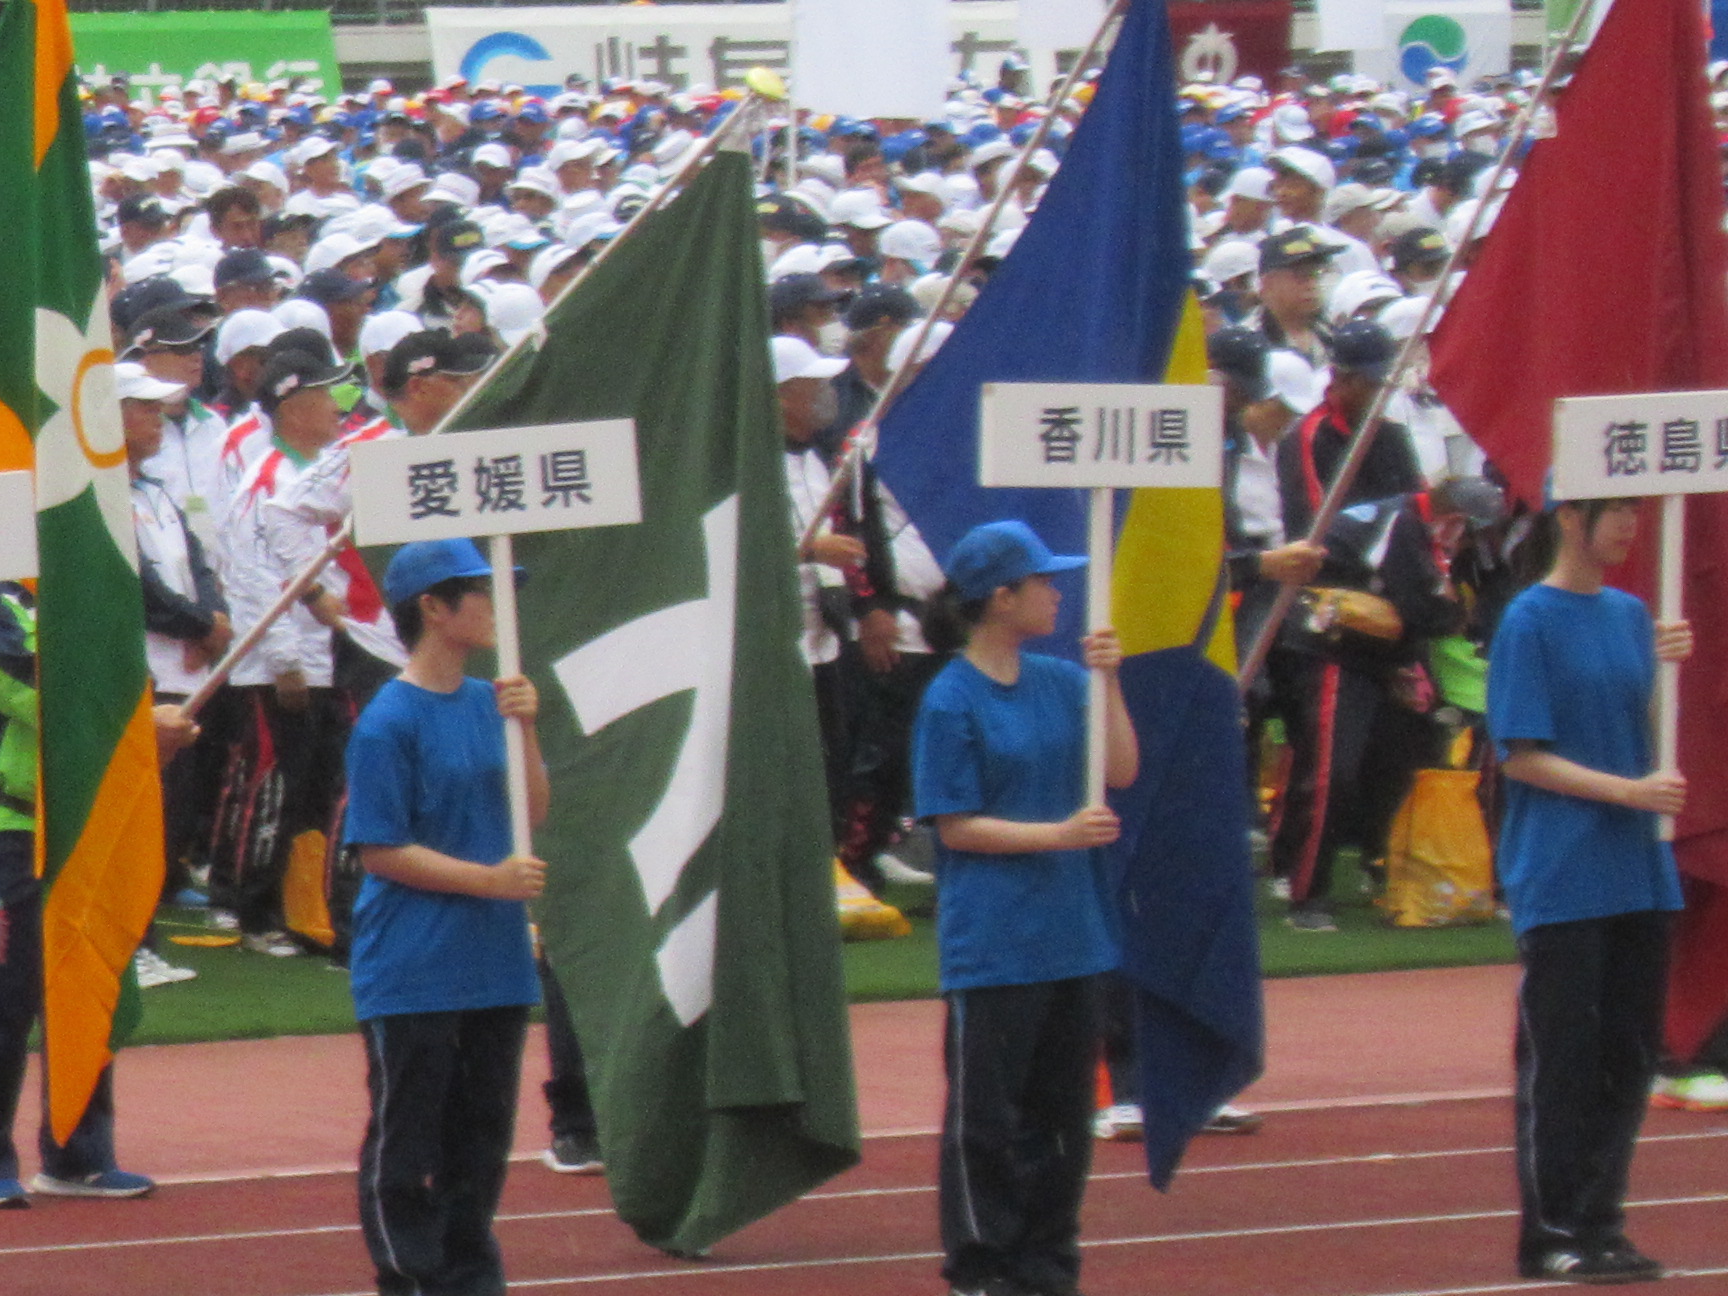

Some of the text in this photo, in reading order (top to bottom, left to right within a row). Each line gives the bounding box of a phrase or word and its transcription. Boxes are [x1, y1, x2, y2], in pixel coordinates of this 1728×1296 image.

[1040, 407, 1190, 465] 香川県
[408, 449, 592, 520] 愛媛県
